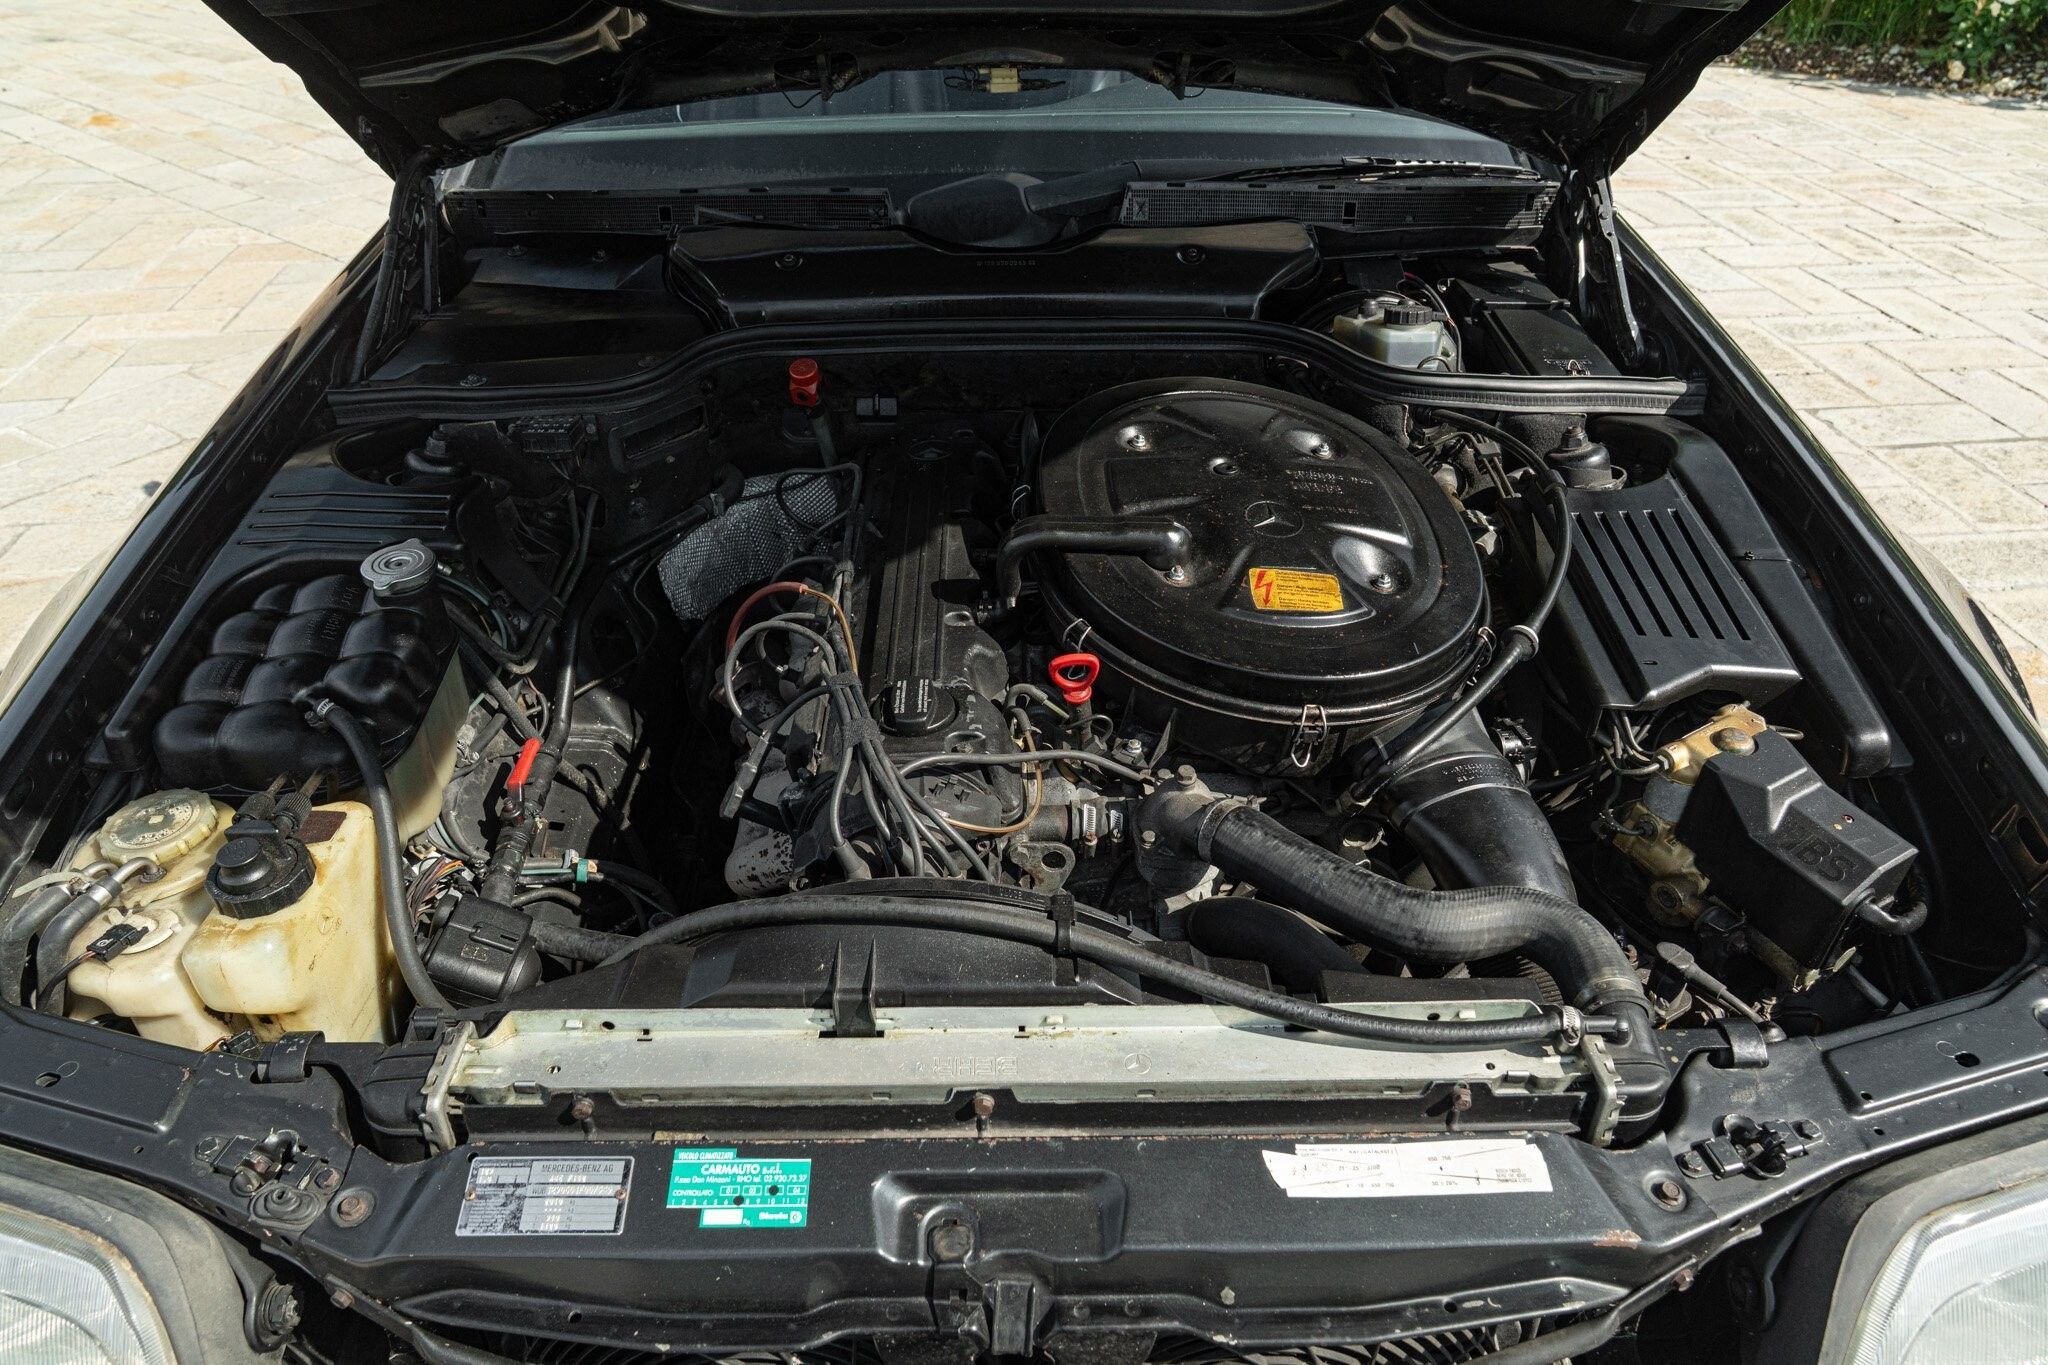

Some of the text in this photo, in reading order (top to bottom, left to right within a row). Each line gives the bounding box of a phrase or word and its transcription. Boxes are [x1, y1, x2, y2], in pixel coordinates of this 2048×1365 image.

[541, 1163, 614, 1173] MERCEDES-BENZ AG
[701, 1163, 760, 1175] CARMAUTO
[736, 1174, 752, 1183] RHO
